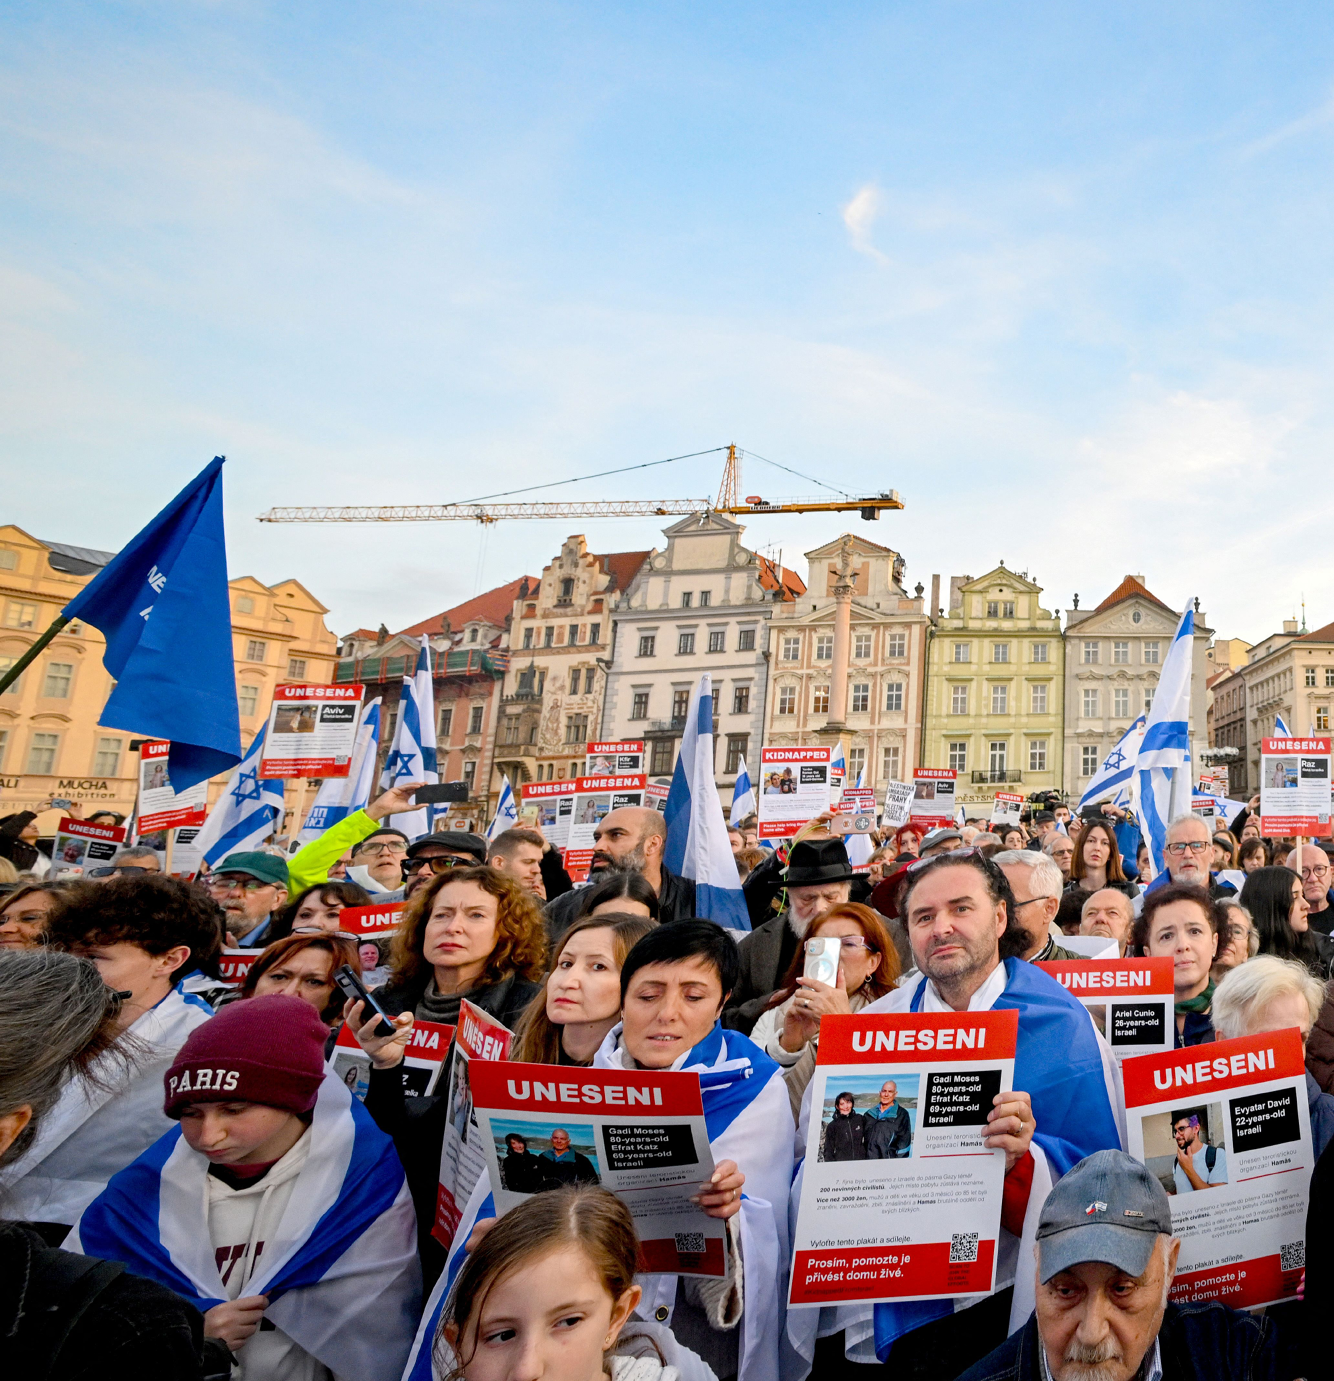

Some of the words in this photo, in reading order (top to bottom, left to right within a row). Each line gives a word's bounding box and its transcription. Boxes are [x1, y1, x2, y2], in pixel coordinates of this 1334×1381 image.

[284, 688, 355, 697] UNESENA
[323, 706, 345, 714] Aviv
[594, 744, 638, 752] UNESEN
[1269, 741, 1325, 750] UNESENA
[765, 751, 827, 760] KIDNAPPED
[1301, 760, 1316, 768] Raz
[58, 779, 108, 790] MUCHA
[582, 777, 640, 788] UNESENA
[529, 783, 576, 794] UNESEN
[48, 791, 116, 799] exhibition
[998, 793, 1022, 801] UNESEN
[840, 801, 874, 809] KIDNPPED
[68, 823, 114, 838] UNESENI
[360, 911, 403, 927] UNE
[1056, 970, 1151, 989] UNESENI
[1115, 1010, 1132, 1018] Ariel
[1115, 1019, 1159, 1028] 26-years-old
[1115, 1028, 1137, 1036] Israeli
[407, 1028, 440, 1050] ENA
[462, 1015, 504, 1061] UNESEN
[851, 1027, 986, 1053] UNESENI
[1153, 1048, 1276, 1090] UNESENI
[169, 1068, 240, 1097] PARIS
[932, 1075, 952, 1084] Gadi
[953, 1075, 980, 1083] Moses
[506, 1079, 663, 1106] UNESENI
[931, 1084, 982, 1094] 80-years-old
[930, 1095, 951, 1103] Efrat
[952, 1094, 971, 1102] Katz
[929, 1104, 980, 1114] 69-years-old
[1234, 1103, 1266, 1115] Evyatar
[1267, 1096, 1291, 1109] David
[928, 1115, 954, 1124] Israeli
[1235, 1109, 1286, 1126] 22-years-old
[1236, 1124, 1262, 1137] Israeli
[609, 1135, 670, 1144] 80-years-old
[926, 1134, 952, 1142] Uneseni
[612, 1151, 673, 1159] 69-years-old
[1239, 1157, 1261, 1166] Unesen
[1271, 1157, 1292, 1166] Hamás
[831, 1185, 861, 1193] nevinných
[857, 1237, 878, 1246] plakát
[807, 1257, 849, 1269] Prosím,
[852, 1255, 899, 1269] pomozte
[900, 1253, 911, 1265] je
[1176, 1263, 1194, 1273] tento
[1194, 1259, 1214, 1271] plakát
[805, 1271, 844, 1285] přivést
[846, 1270, 877, 1280] domu
[879, 1267, 904, 1279] živé.
[1194, 1273, 1236, 1289] pomozte
[1237, 1270, 1247, 1281] je
[1191, 1288, 1219, 1301] domu
[1221, 1284, 1243, 1295] živé.
